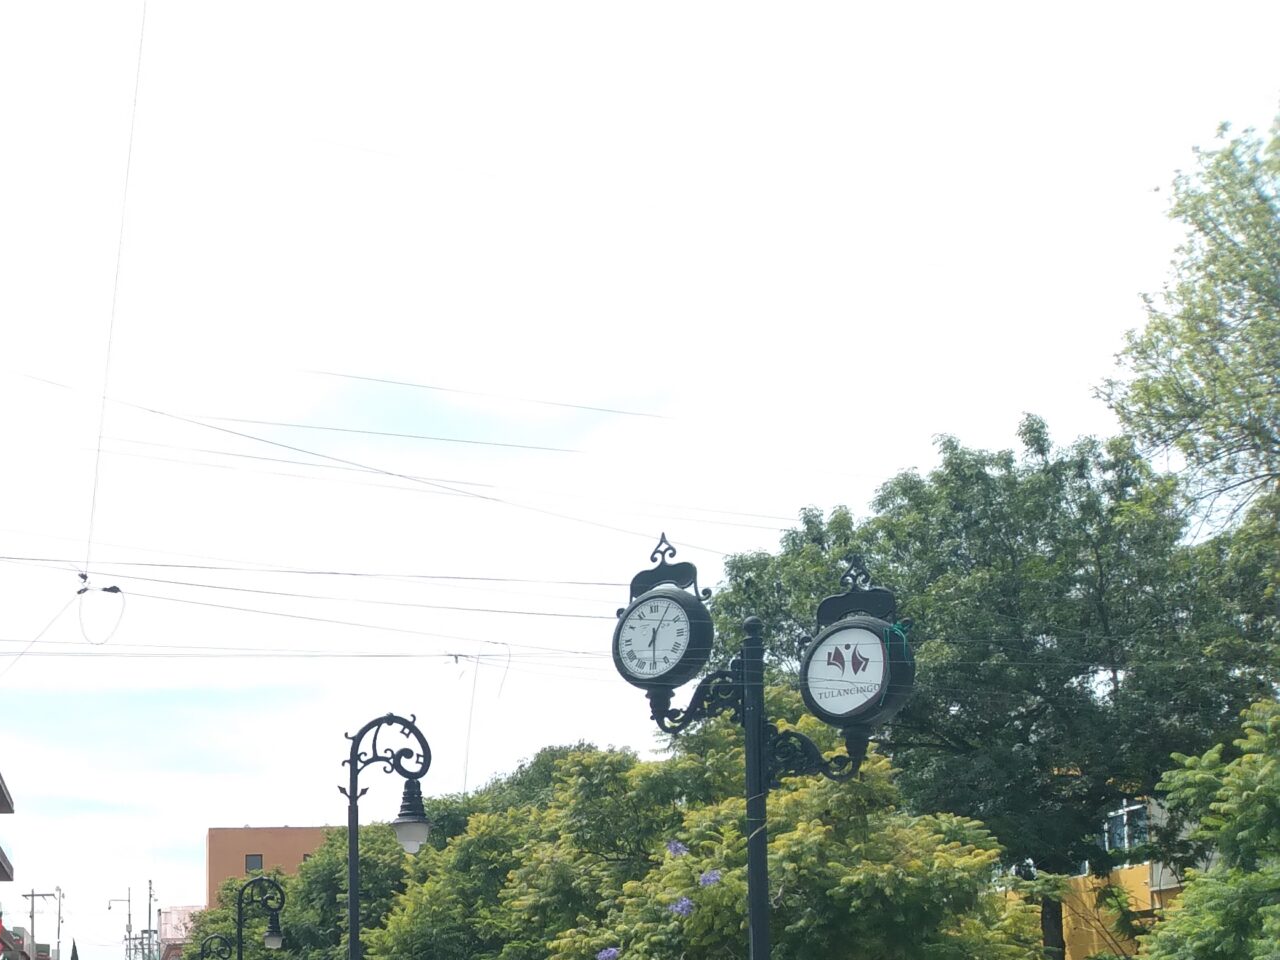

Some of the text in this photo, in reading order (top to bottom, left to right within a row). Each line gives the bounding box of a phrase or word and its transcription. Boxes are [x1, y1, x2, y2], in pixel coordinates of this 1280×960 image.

[650, 605, 659, 614] XII
[676, 628, 684, 637] III
[817, 684, 880, 700] TULANCINGO
